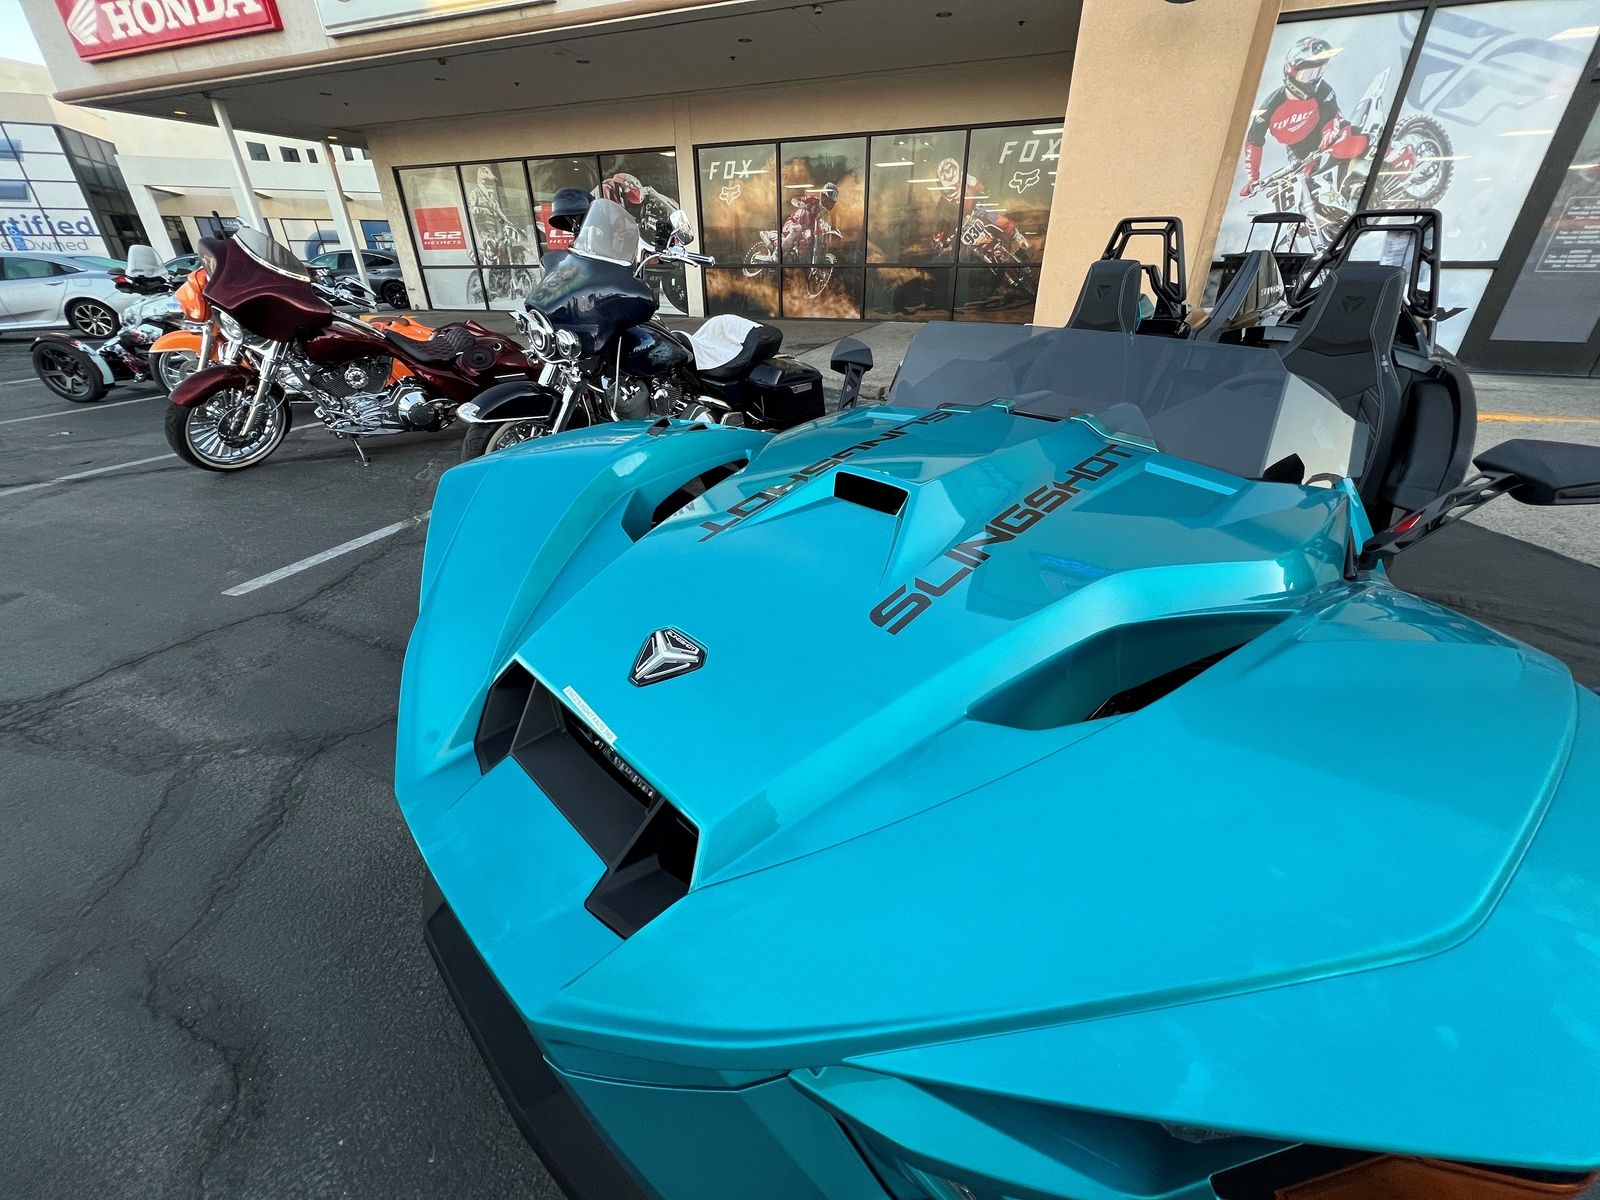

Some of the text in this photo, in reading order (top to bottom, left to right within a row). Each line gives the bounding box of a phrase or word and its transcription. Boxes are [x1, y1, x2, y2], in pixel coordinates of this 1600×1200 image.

[101, 0, 262, 40] HONDA
[999, 139, 1062, 164] FOX
[709, 160, 752, 180] FOX
[1272, 186, 1295, 212] 16
[423, 231, 462, 240] LS2
[963, 221, 984, 245] 930
[698, 411, 953, 543] SLINGSHOT
[869, 444, 1133, 636] SLINGSHOT
